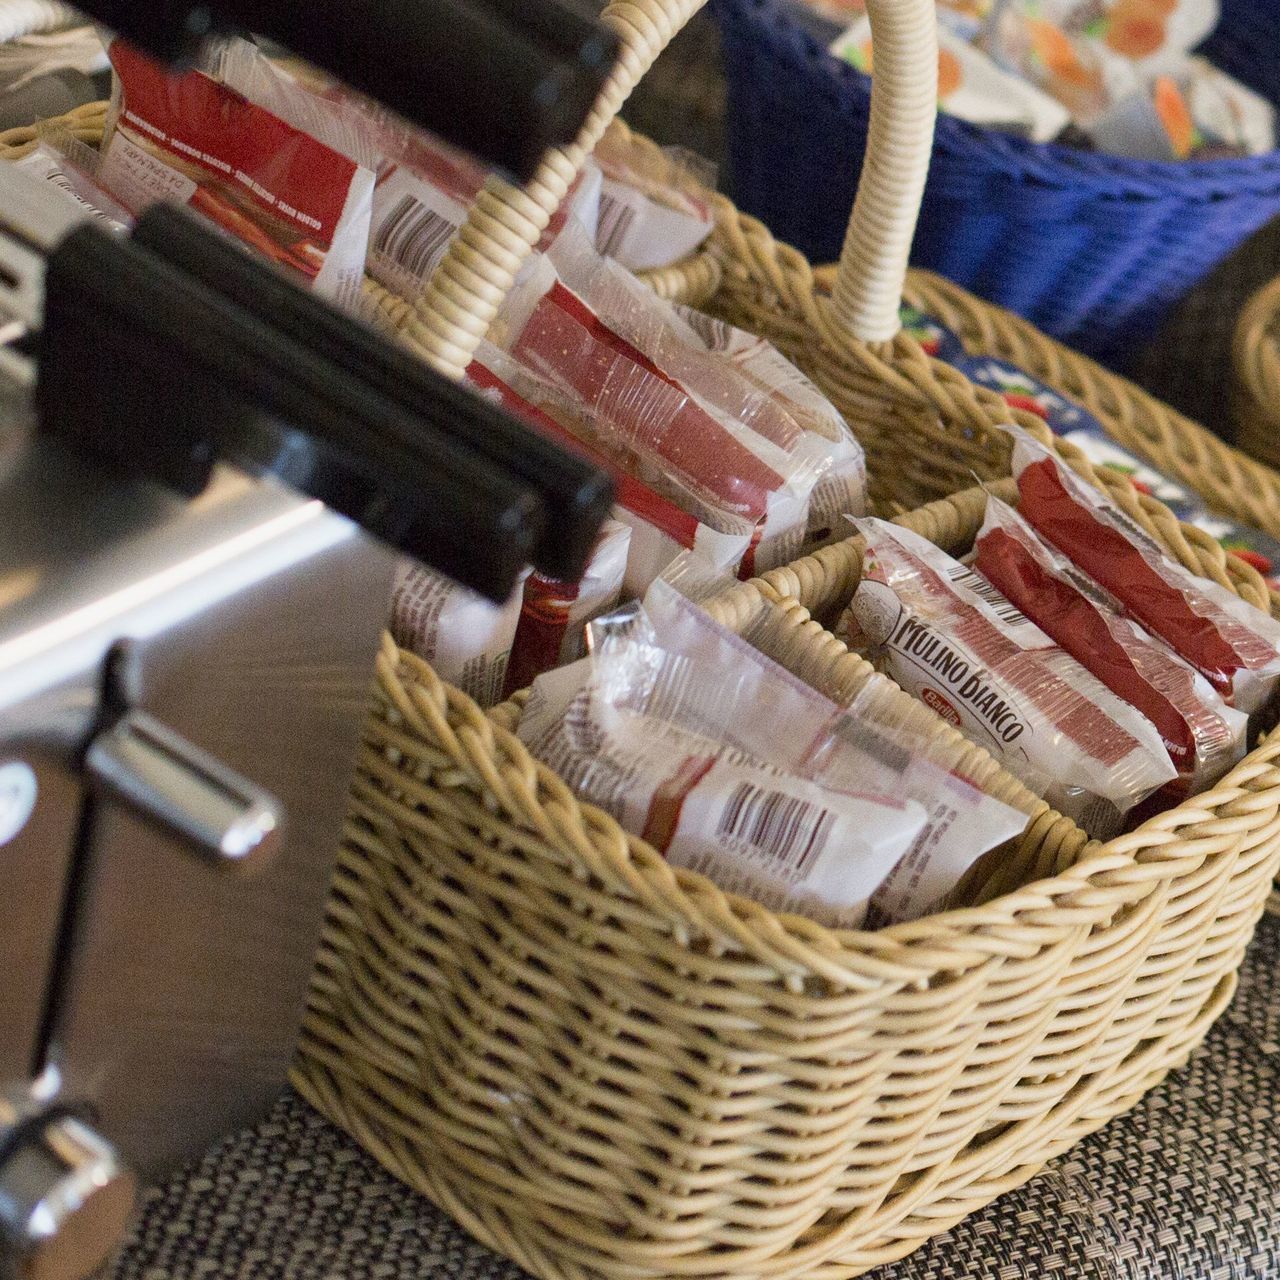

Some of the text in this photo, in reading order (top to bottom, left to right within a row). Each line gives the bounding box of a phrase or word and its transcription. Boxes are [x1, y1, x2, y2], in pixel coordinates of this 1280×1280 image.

[893, 616, 970, 684] MULINO
[957, 669, 1025, 743] BIANCO
[924, 689, 961, 725] Barilla
